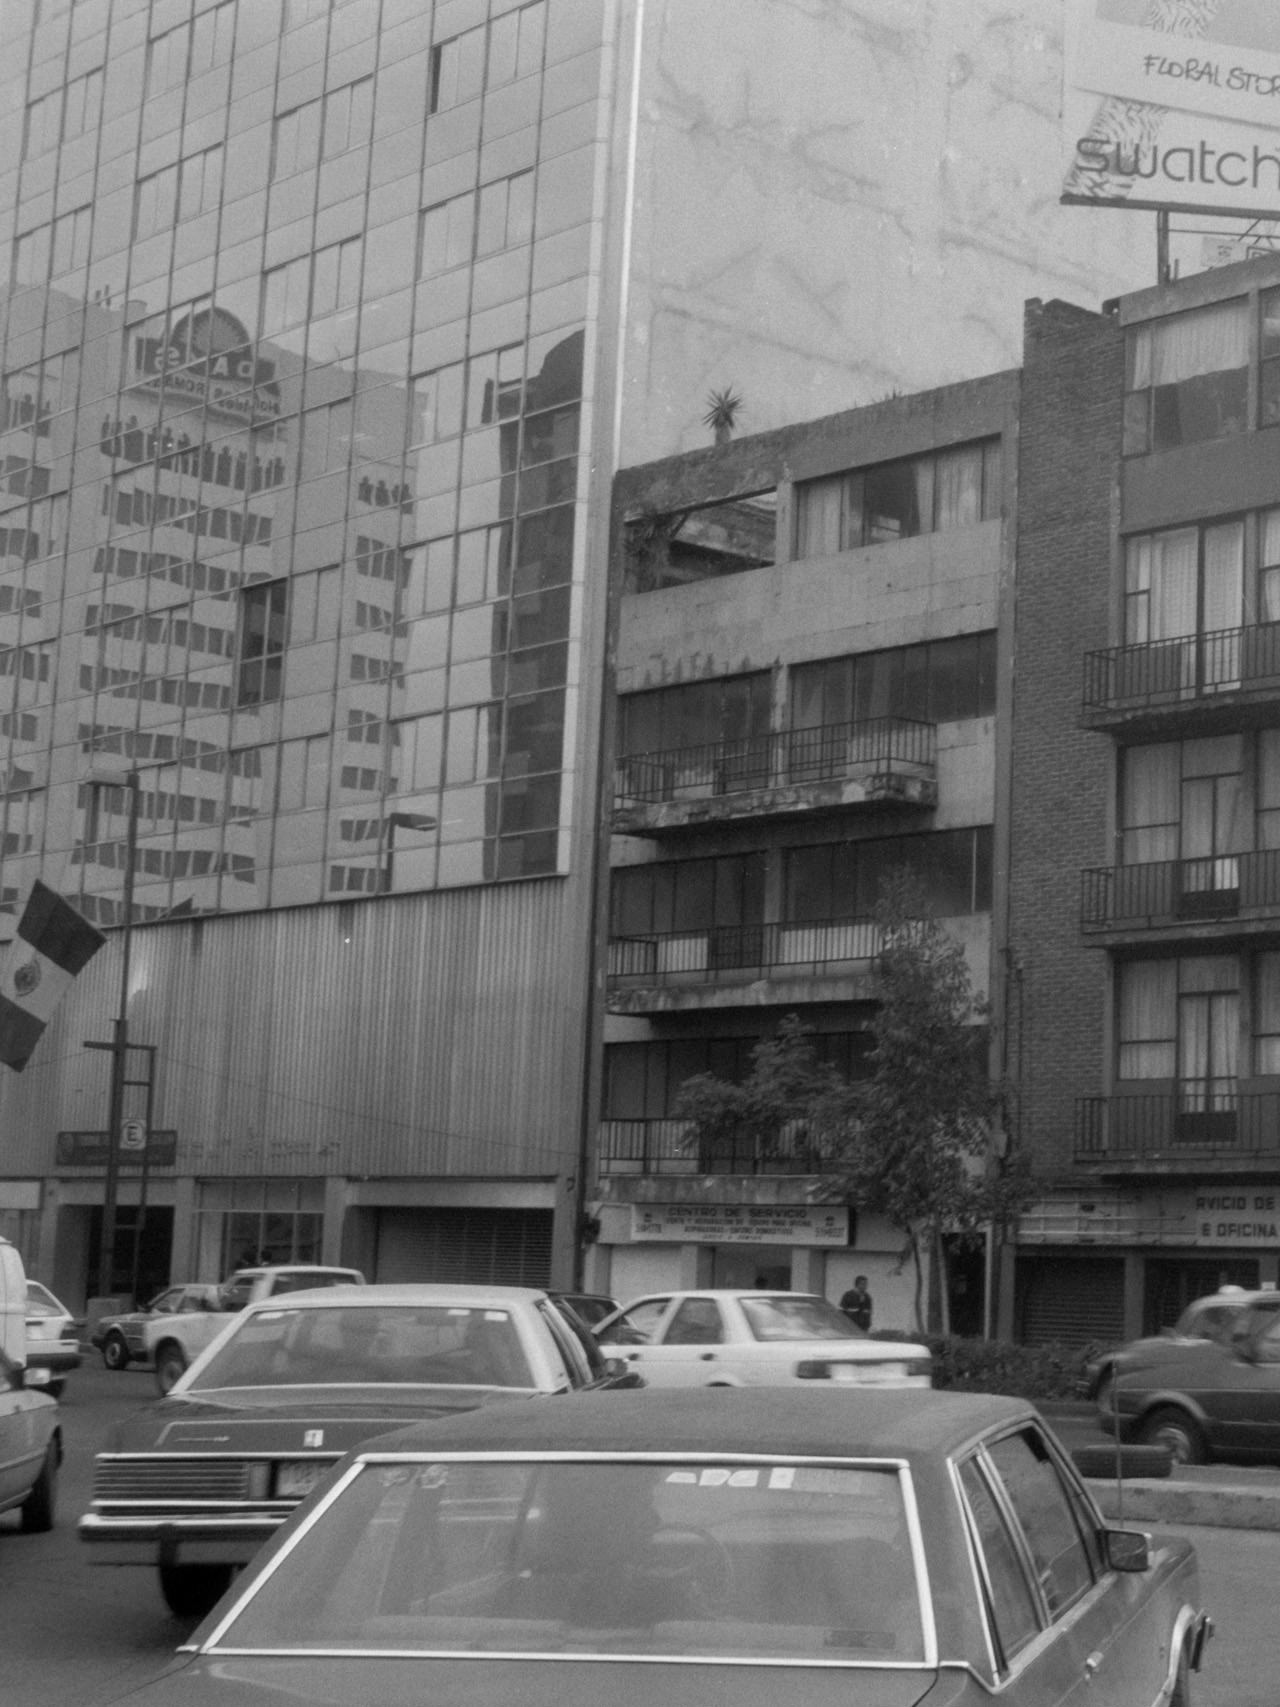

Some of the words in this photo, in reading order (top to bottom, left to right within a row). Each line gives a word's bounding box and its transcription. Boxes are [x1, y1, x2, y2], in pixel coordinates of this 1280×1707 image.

[1143, 53, 1222, 88] FLORAL
[126, 1125, 138, 1142] E
[1253, 1196, 1275, 1211] DE
[667, 1206, 717, 1218] CENTRO
[724, 1207, 741, 1217] DE
[749, 1207, 808, 1219] SERVICIO
[1216, 1222, 1278, 1237] OFICINA
